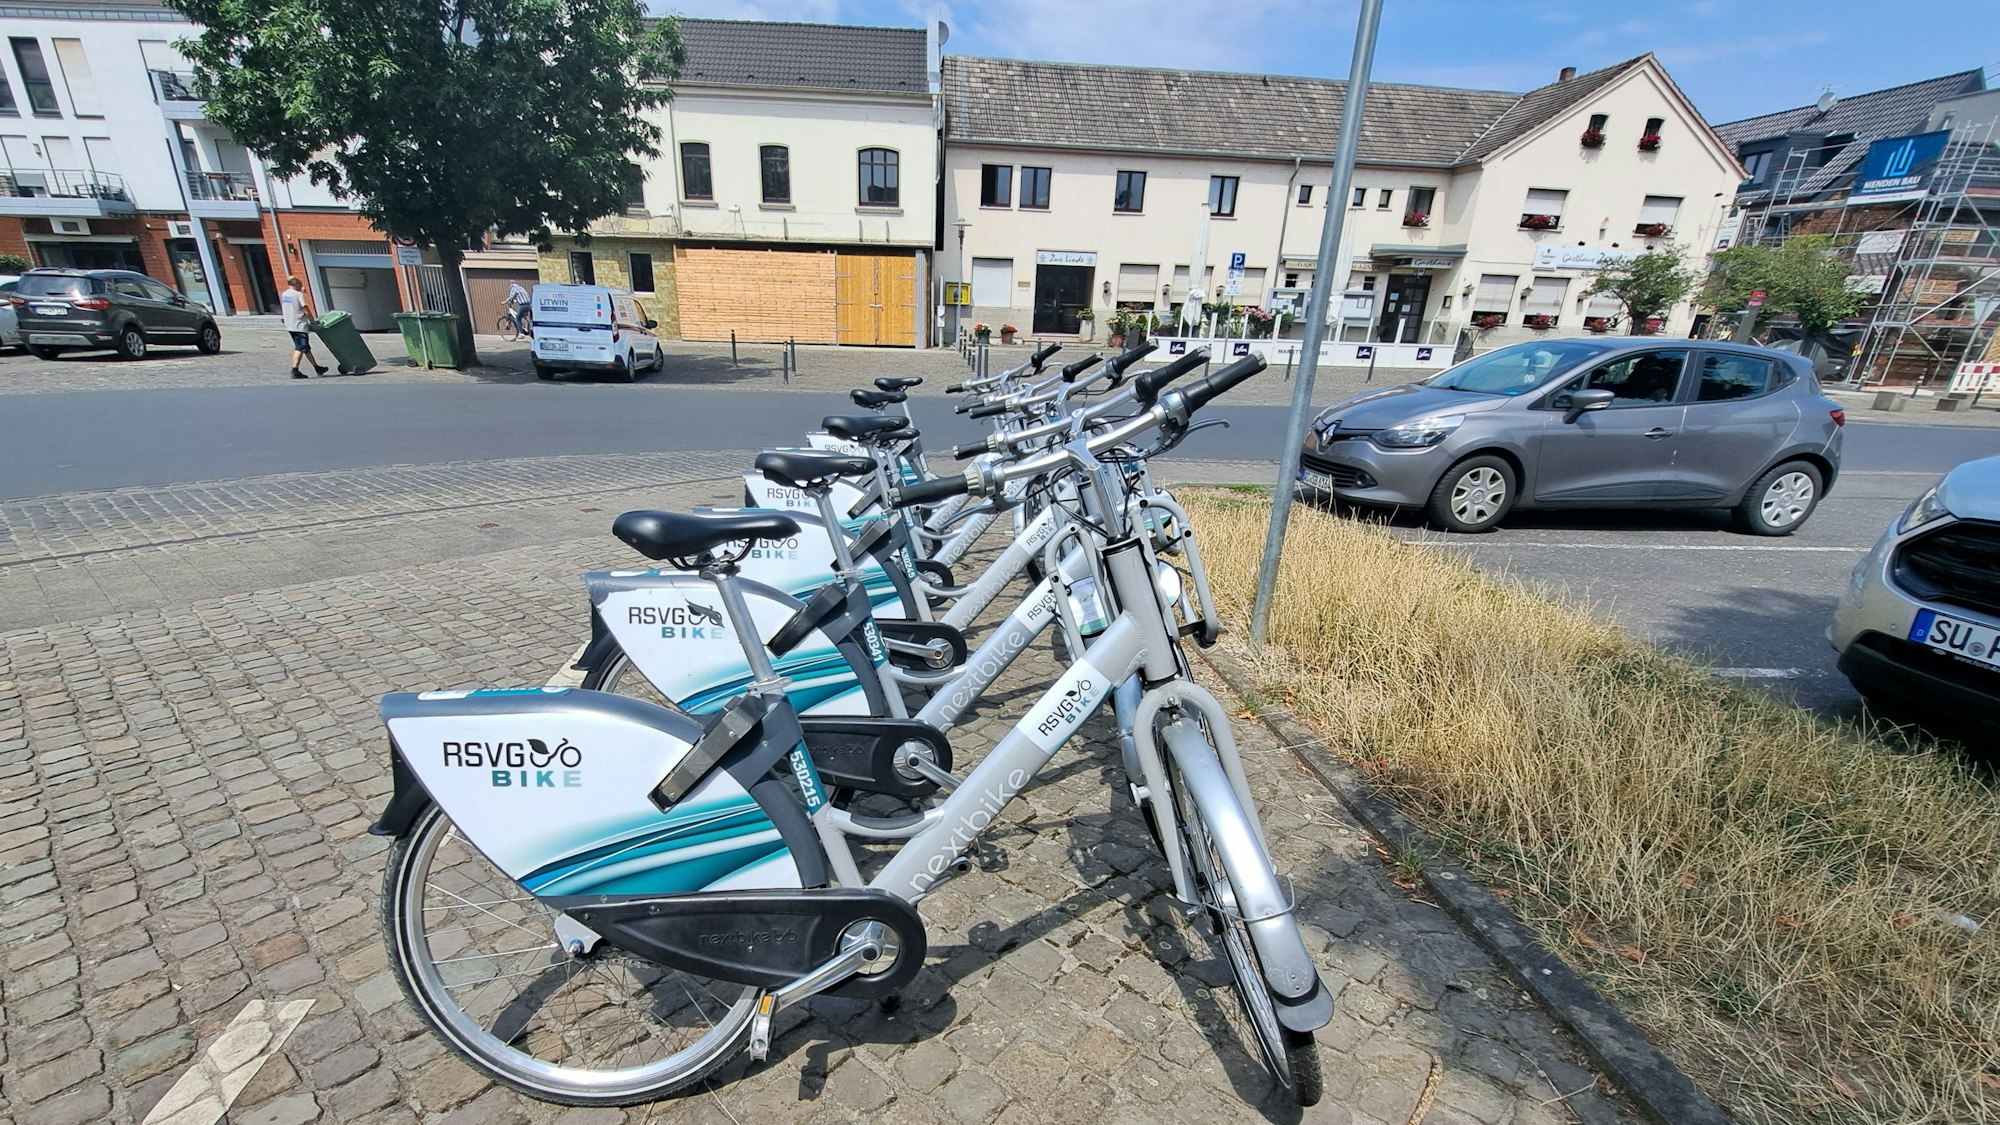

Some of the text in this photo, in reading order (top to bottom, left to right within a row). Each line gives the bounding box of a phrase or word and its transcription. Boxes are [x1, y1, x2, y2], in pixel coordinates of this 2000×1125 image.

[1863, 178, 1900, 189] MENDEN
[1901, 175, 1921, 186] BAU
[1233, 254, 1243, 268] P
[1414, 258, 1451, 267] Gasthaus
[1562, 252, 1595, 263] Gasthaus
[540, 298, 568, 306] LITWIN
[824, 444, 849, 453] RSVG
[767, 488, 800, 500] RSVG
[945, 512, 995, 564] nextbike
[1026, 527, 1047, 547] RSVG
[751, 549, 798, 560] BIKE
[959, 559, 1023, 626] nextbike
[628, 606, 685, 625] RSVG
[1027, 593, 1055, 621] RSVG
[661, 626, 725, 639] BIKE
[862, 622, 885, 662] 530341
[1929, 619, 1974, 651] SU
[938, 631, 1026, 722] nextbike
[1064, 686, 1100, 725] BIKE
[1037, 698, 1075, 737] RSVG
[442, 741, 525, 768] RSVG
[491, 770, 583, 788] BIKE
[789, 750, 821, 808] 530215
[908, 768, 1032, 893] nextbike
[699, 929, 770, 946] nextbike
